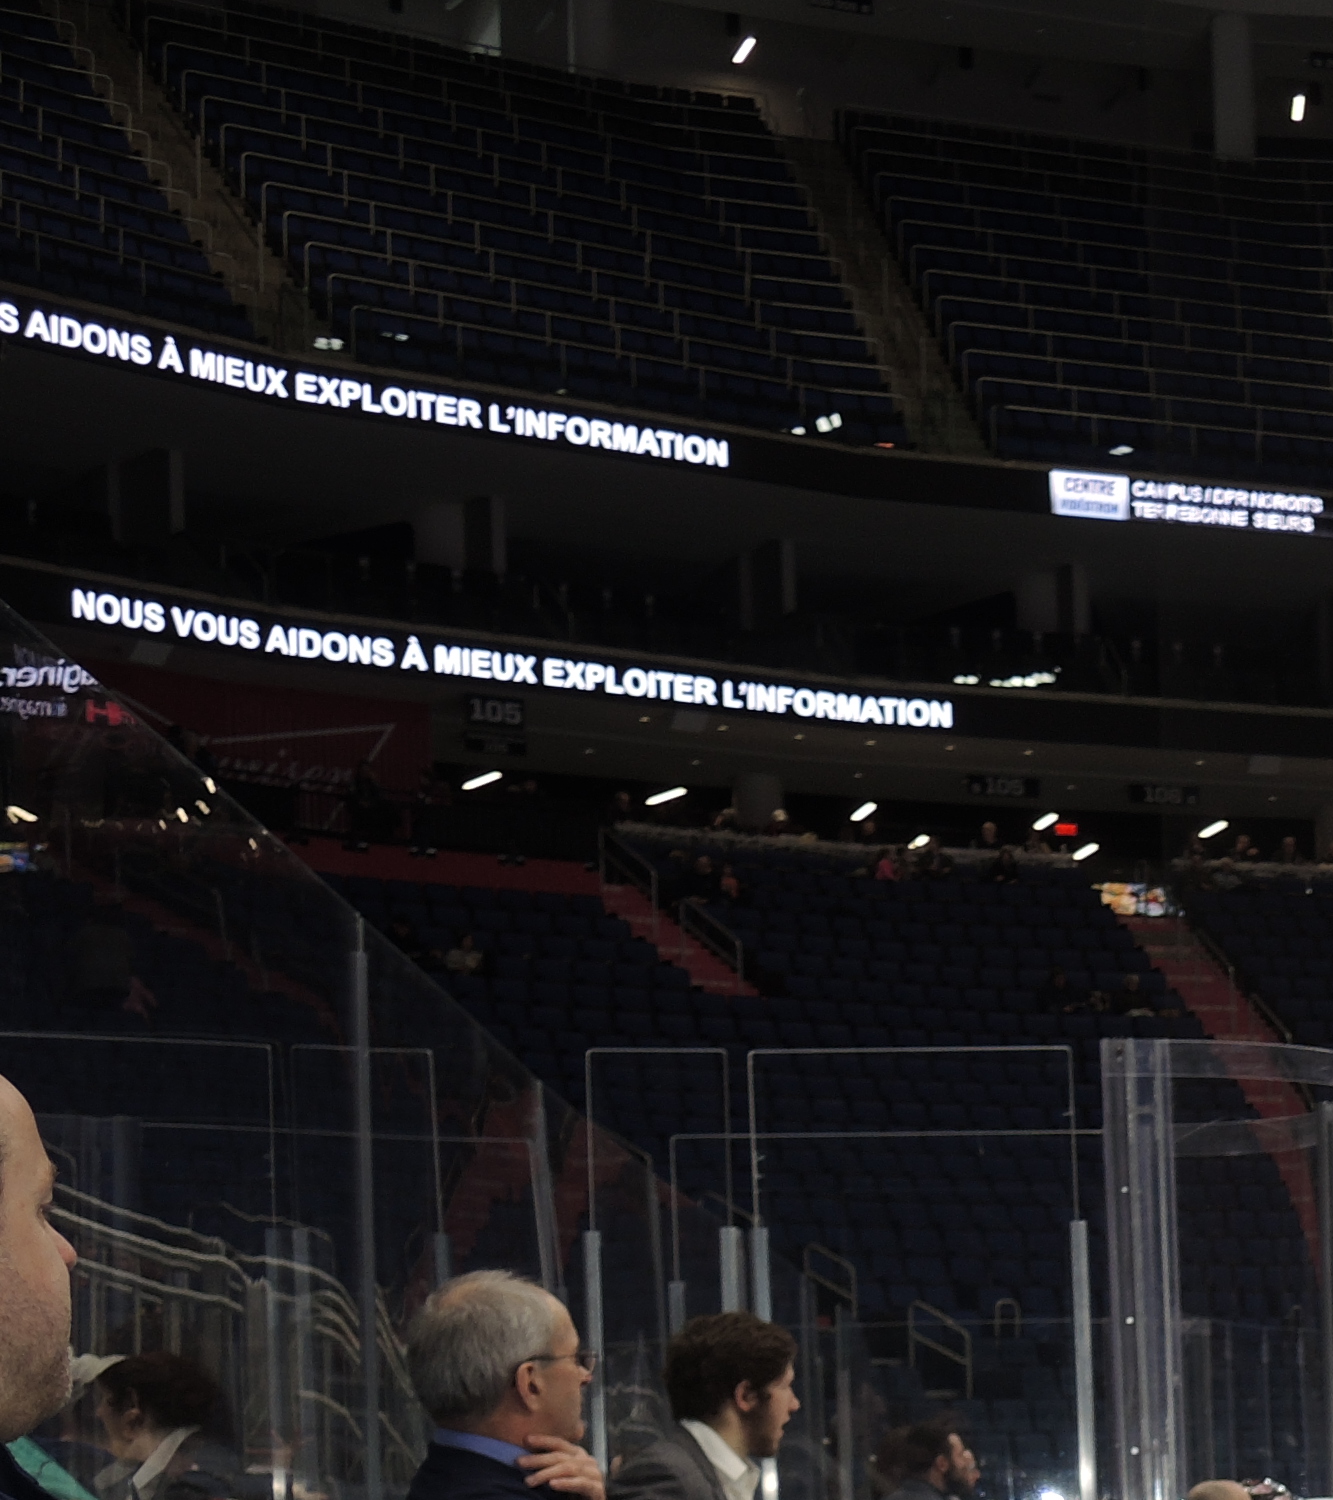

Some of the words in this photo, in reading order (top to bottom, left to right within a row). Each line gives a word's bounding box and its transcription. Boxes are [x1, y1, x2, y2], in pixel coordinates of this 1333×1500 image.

[24, 310, 152, 365] AIDONS
[158, 336, 184, 373] À
[189, 348, 288, 398] MIEUX
[295, 372, 483, 428] EXPLOITER
[489, 403, 729, 467] L'INFORMATION
[72, 589, 165, 632] NOUS
[171, 606, 261, 649] VOUS
[265, 625, 395, 667] AIDONS
[401, 636, 429, 671] À
[434, 644, 538, 684] MIEUX
[543, 658, 718, 705] EXPLOITER
[722, 679, 955, 728] L'INFORMATION
